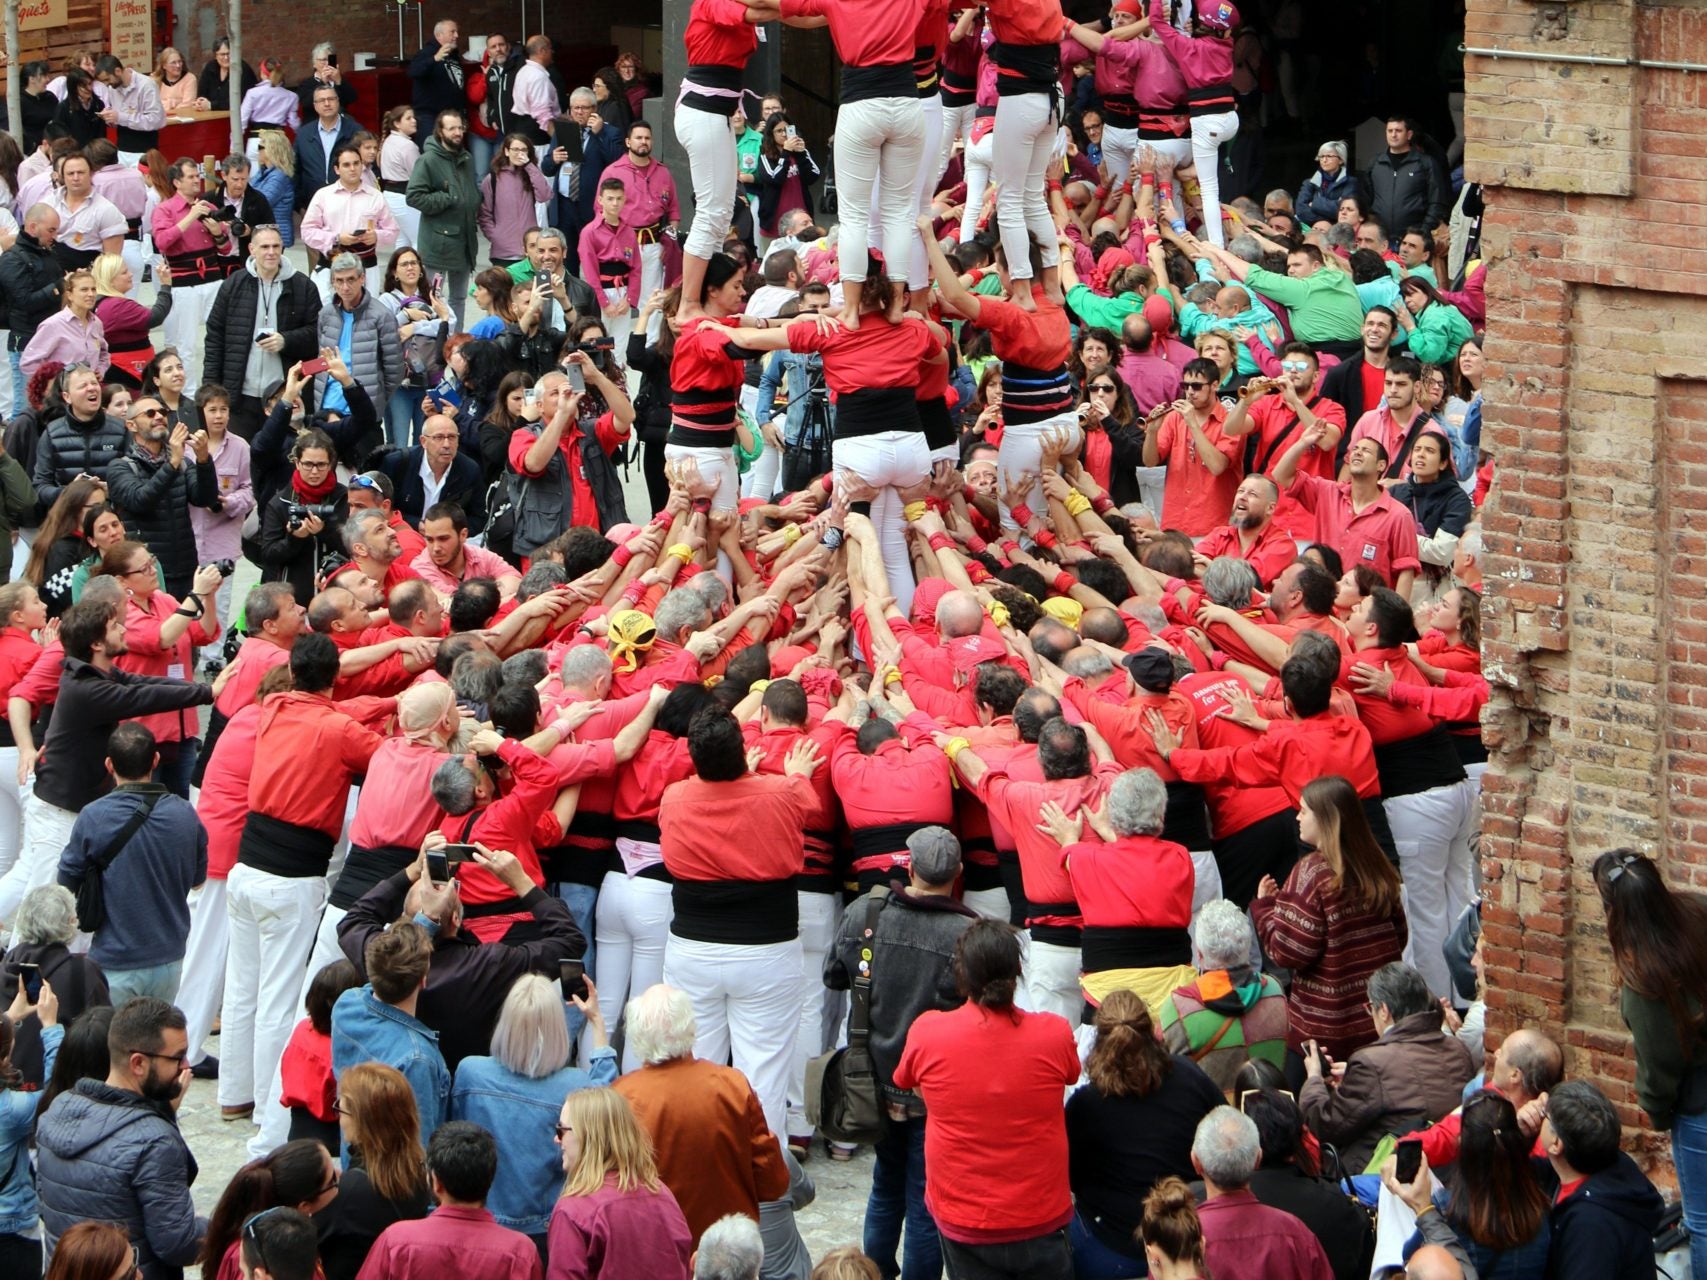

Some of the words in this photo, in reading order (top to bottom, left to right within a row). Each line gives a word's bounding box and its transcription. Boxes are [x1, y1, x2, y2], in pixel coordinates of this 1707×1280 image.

[17, 0, 50, 25] quets
[127, 4, 147, 16] PREUS
[1201, 694, 1216, 706] fer
